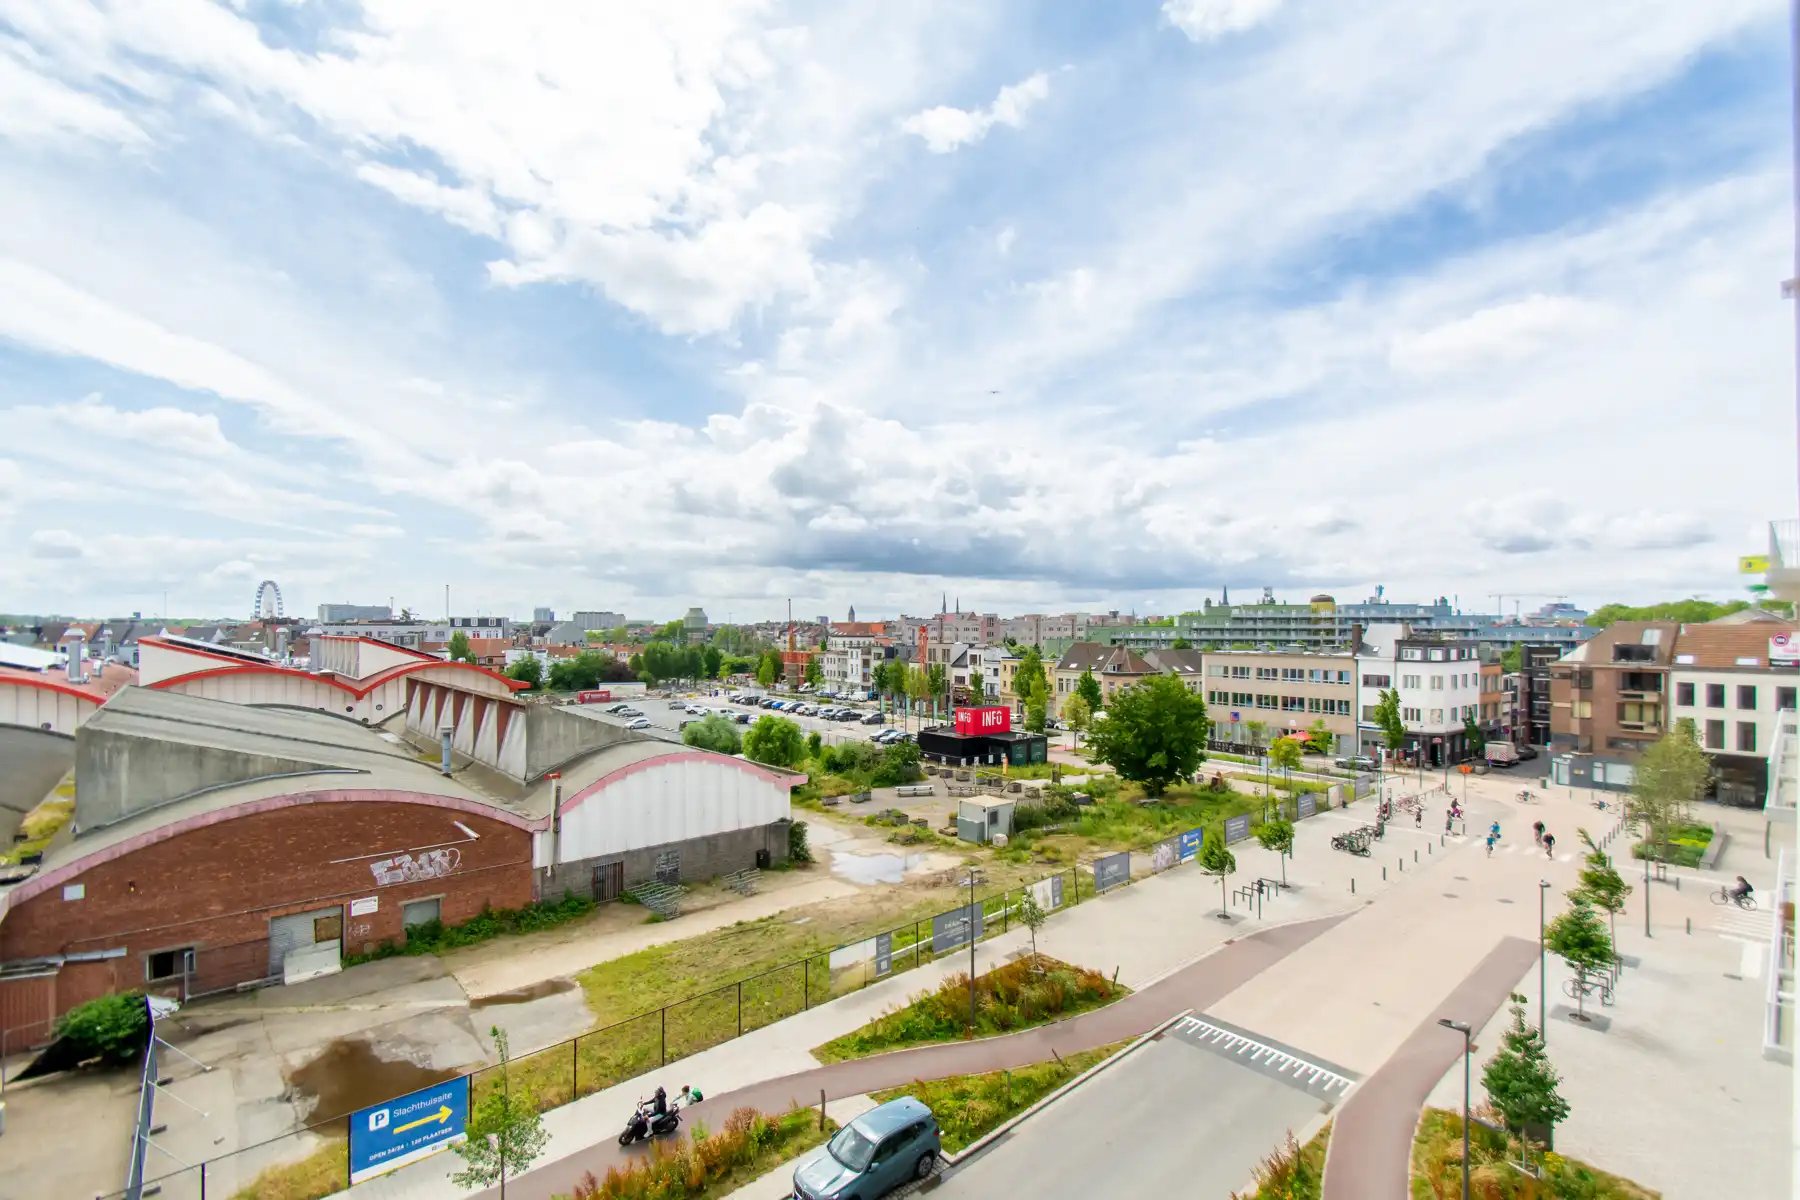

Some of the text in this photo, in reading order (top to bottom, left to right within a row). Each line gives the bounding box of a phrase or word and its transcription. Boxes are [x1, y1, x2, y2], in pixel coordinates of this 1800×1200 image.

[958, 711, 971, 723] INFO
[982, 710, 1003, 726] INFO
[393, 1092, 453, 1118] Slachthuissite
[369, 1151, 387, 1161] OPEN
[387, 1144, 405, 1154] 24/24
[422, 1127, 453, 1141] PLAATSEN
